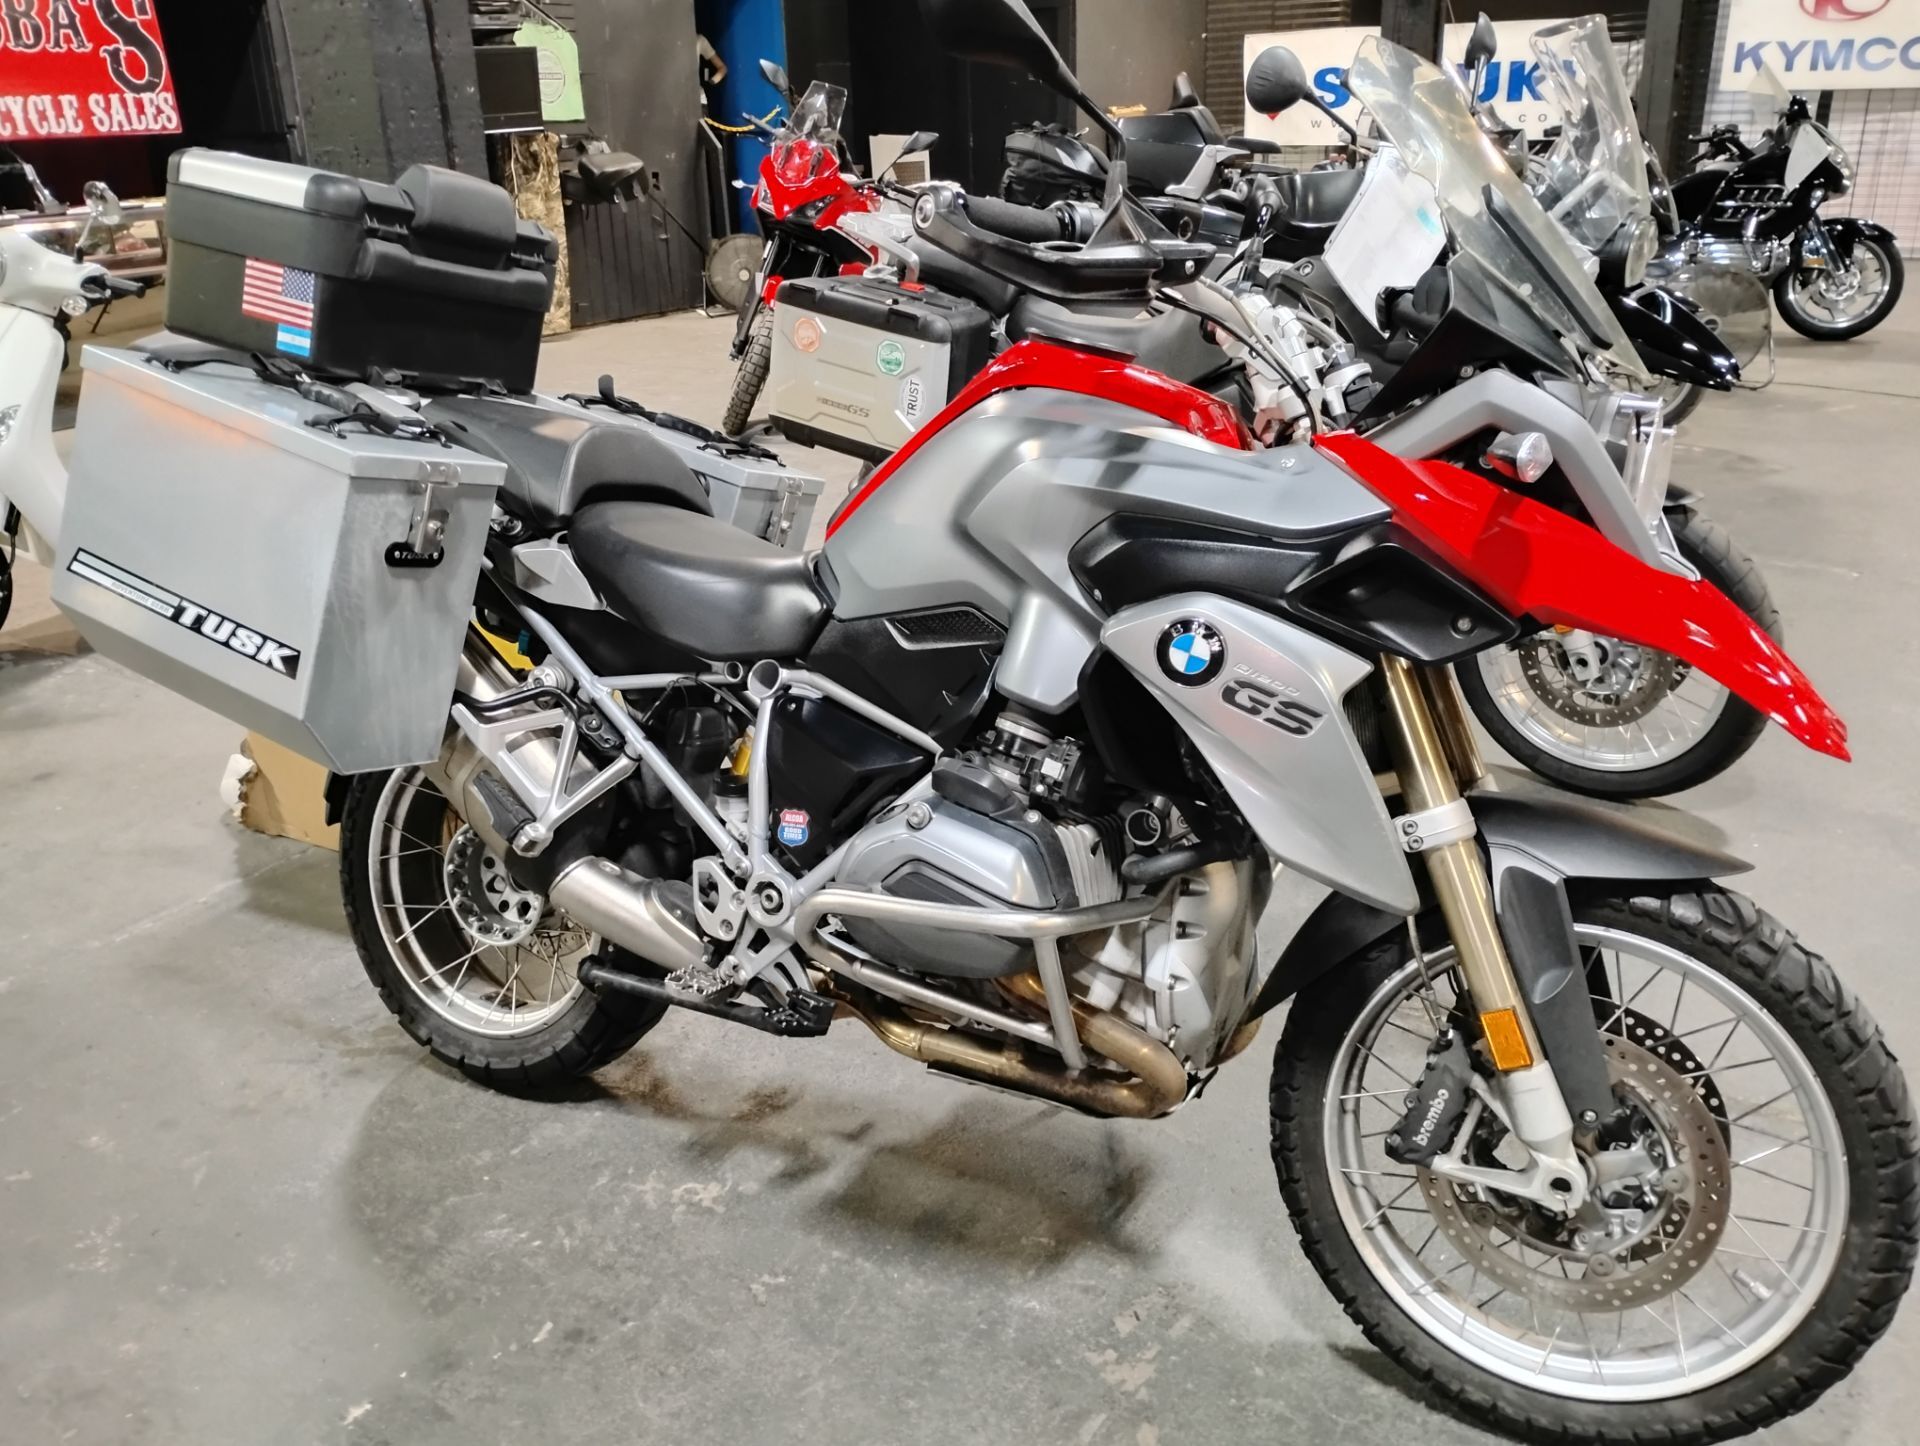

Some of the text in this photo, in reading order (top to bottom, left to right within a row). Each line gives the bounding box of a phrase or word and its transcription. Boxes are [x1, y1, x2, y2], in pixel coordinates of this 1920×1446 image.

[0, 0, 166, 96] BAS
[1733, 36, 1920, 73] KYMCO
[1313, 58, 1579, 109] SUK
[88, 92, 178, 133] SALES
[905, 378, 920, 417] TRUST
[177, 599, 299, 674] TUSK
[1169, 620, 1223, 652] BMW
[1221, 679, 1323, 736] GS
[1411, 1088, 1450, 1147] brembo
